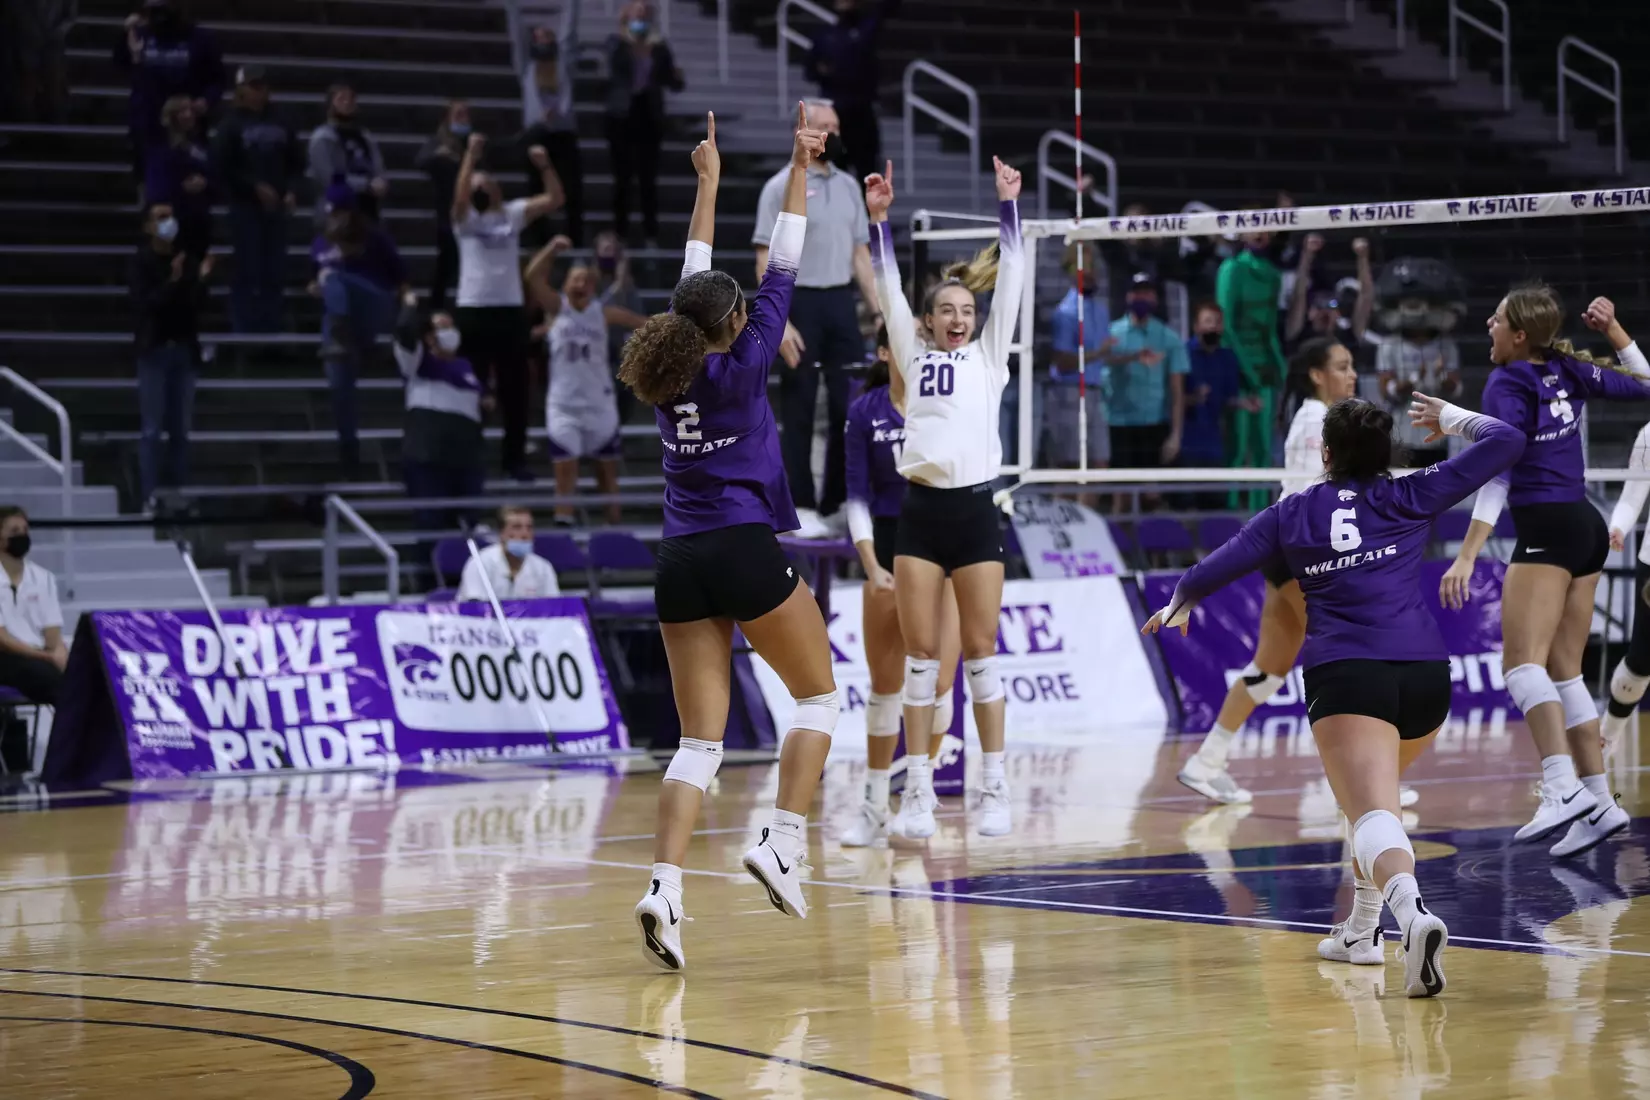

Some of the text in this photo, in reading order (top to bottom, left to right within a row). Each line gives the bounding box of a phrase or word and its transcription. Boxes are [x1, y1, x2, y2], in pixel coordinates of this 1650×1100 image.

[1235, 210, 1299, 227] K-STATE
[1350, 203, 1415, 221] K-STATE
[1468, 197, 1537, 215] K-STATE
[1127, 216, 1188, 232] K-STATE
[920, 363, 955, 396] 20
[673, 402, 702, 440] 2
[1330, 507, 1362, 553] 6
[1304, 544, 1397, 576] WILDCATS
[181, 617, 358, 677] DRIVE
[450, 652, 583, 702] 00000
[192, 670, 352, 730] WITH
[207, 718, 400, 775] PRIDE!
